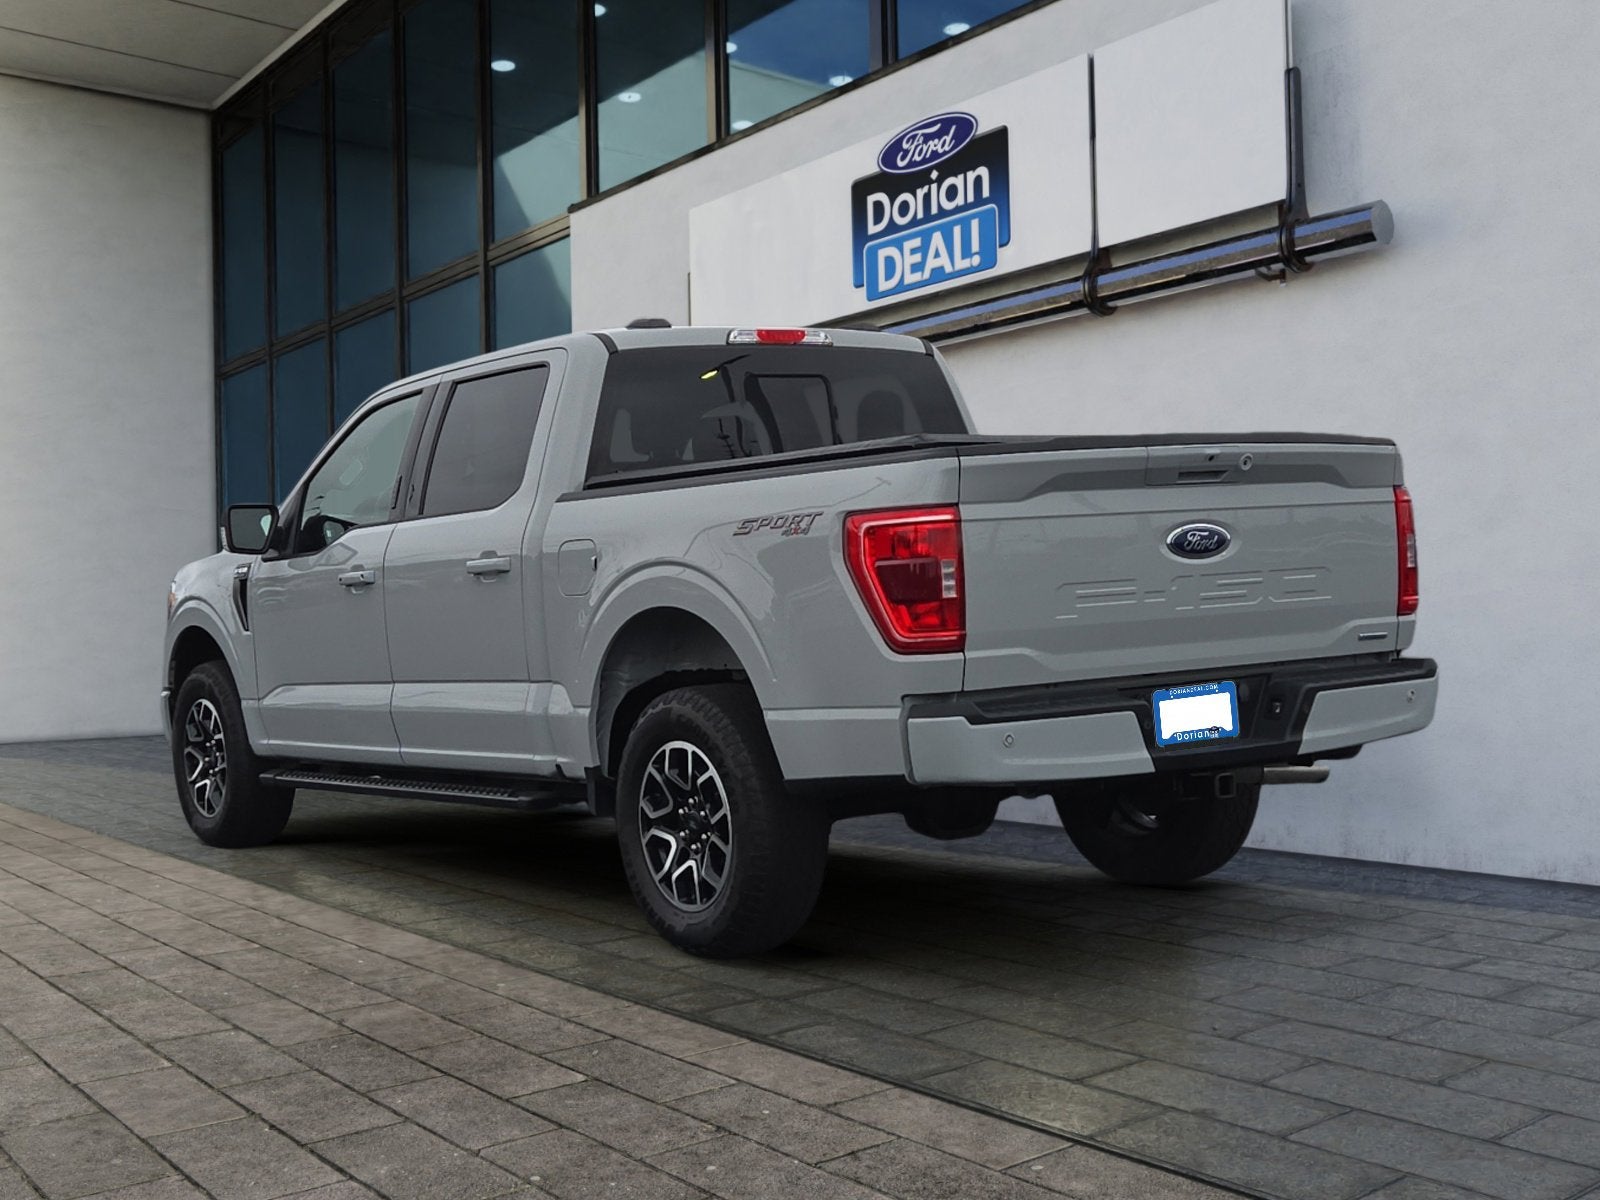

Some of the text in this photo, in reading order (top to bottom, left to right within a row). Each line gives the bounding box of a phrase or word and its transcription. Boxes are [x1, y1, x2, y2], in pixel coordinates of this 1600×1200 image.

[896, 123, 957, 168] Ford
[866, 165, 991, 236] Dorian
[877, 217, 982, 293] DEAL!
[732, 511, 824, 537] SPORT
[1183, 530, 1220, 551] Ford
[1176, 729, 1210, 741] Dorian
